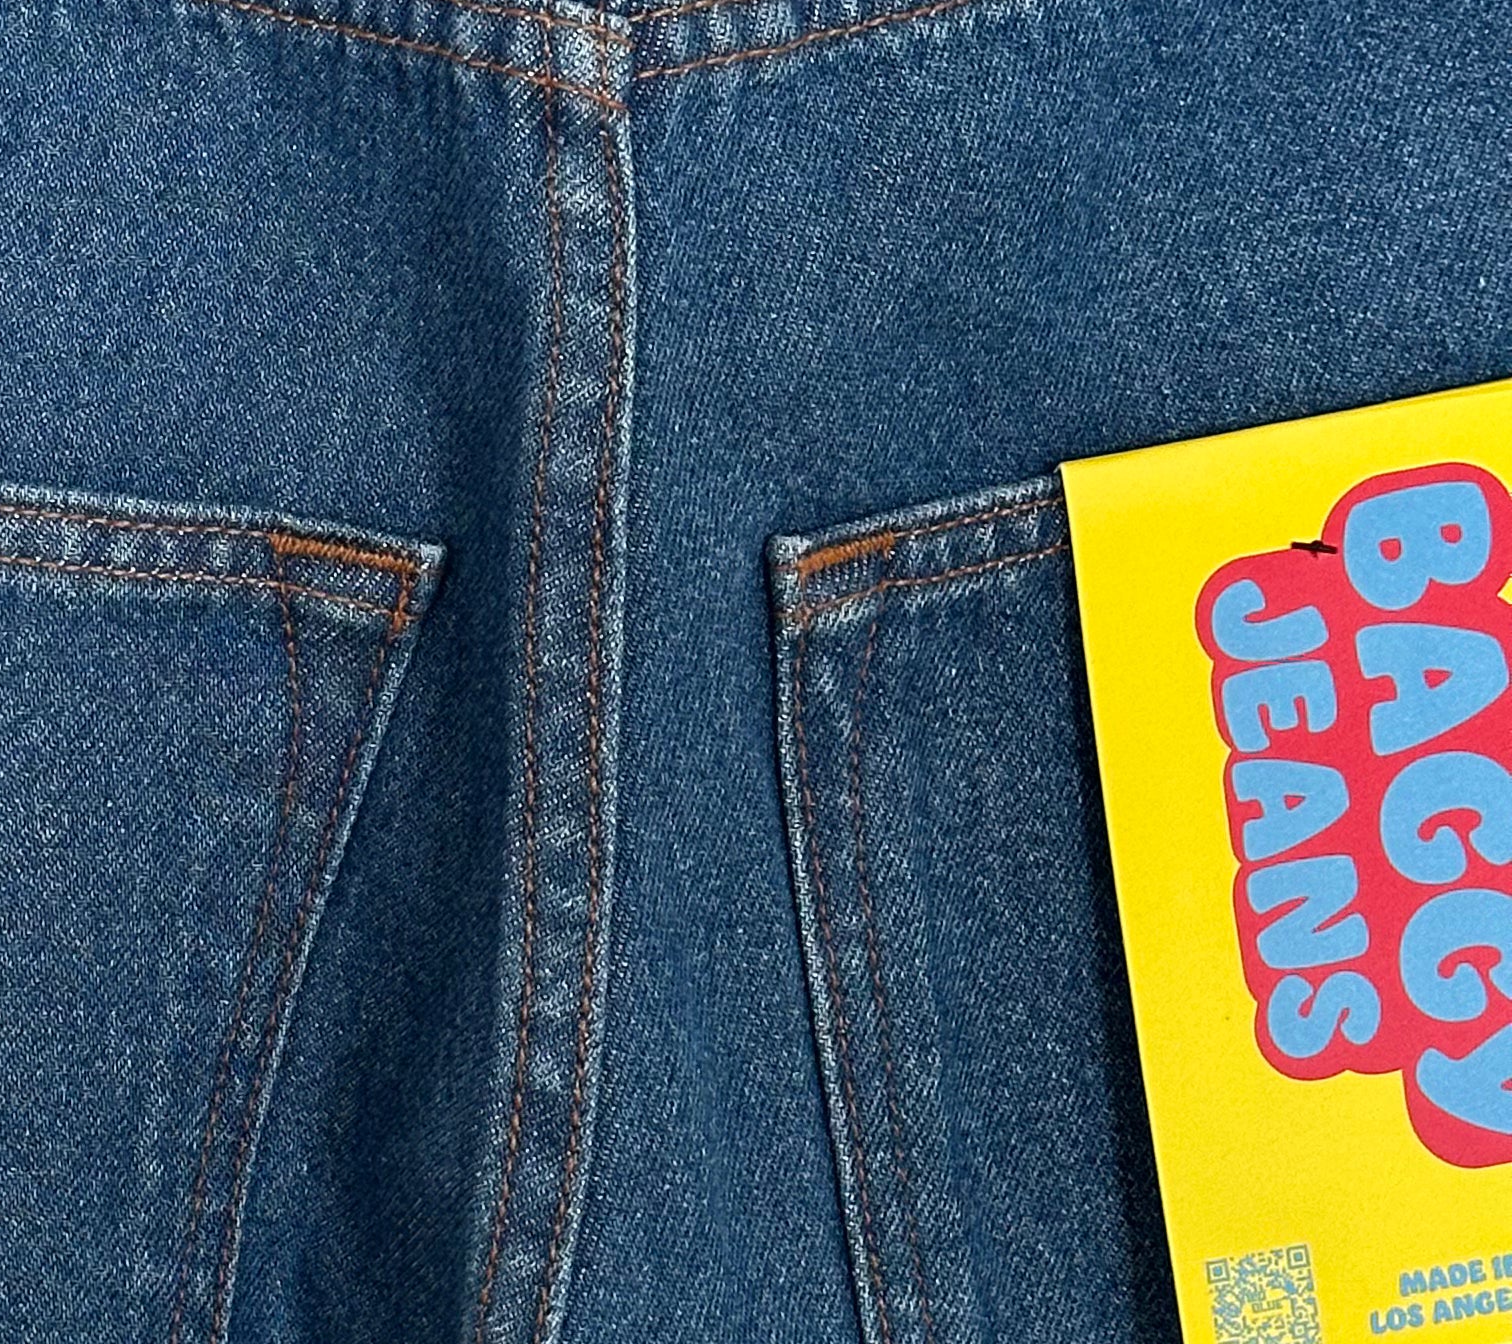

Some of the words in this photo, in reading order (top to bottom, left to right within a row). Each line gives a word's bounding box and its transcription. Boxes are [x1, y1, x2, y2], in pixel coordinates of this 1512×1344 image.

[1211, 578, 1382, 1058] JEANS
[1399, 1259, 1487, 1297] MADE
[1370, 1303, 1425, 1334] LOS
